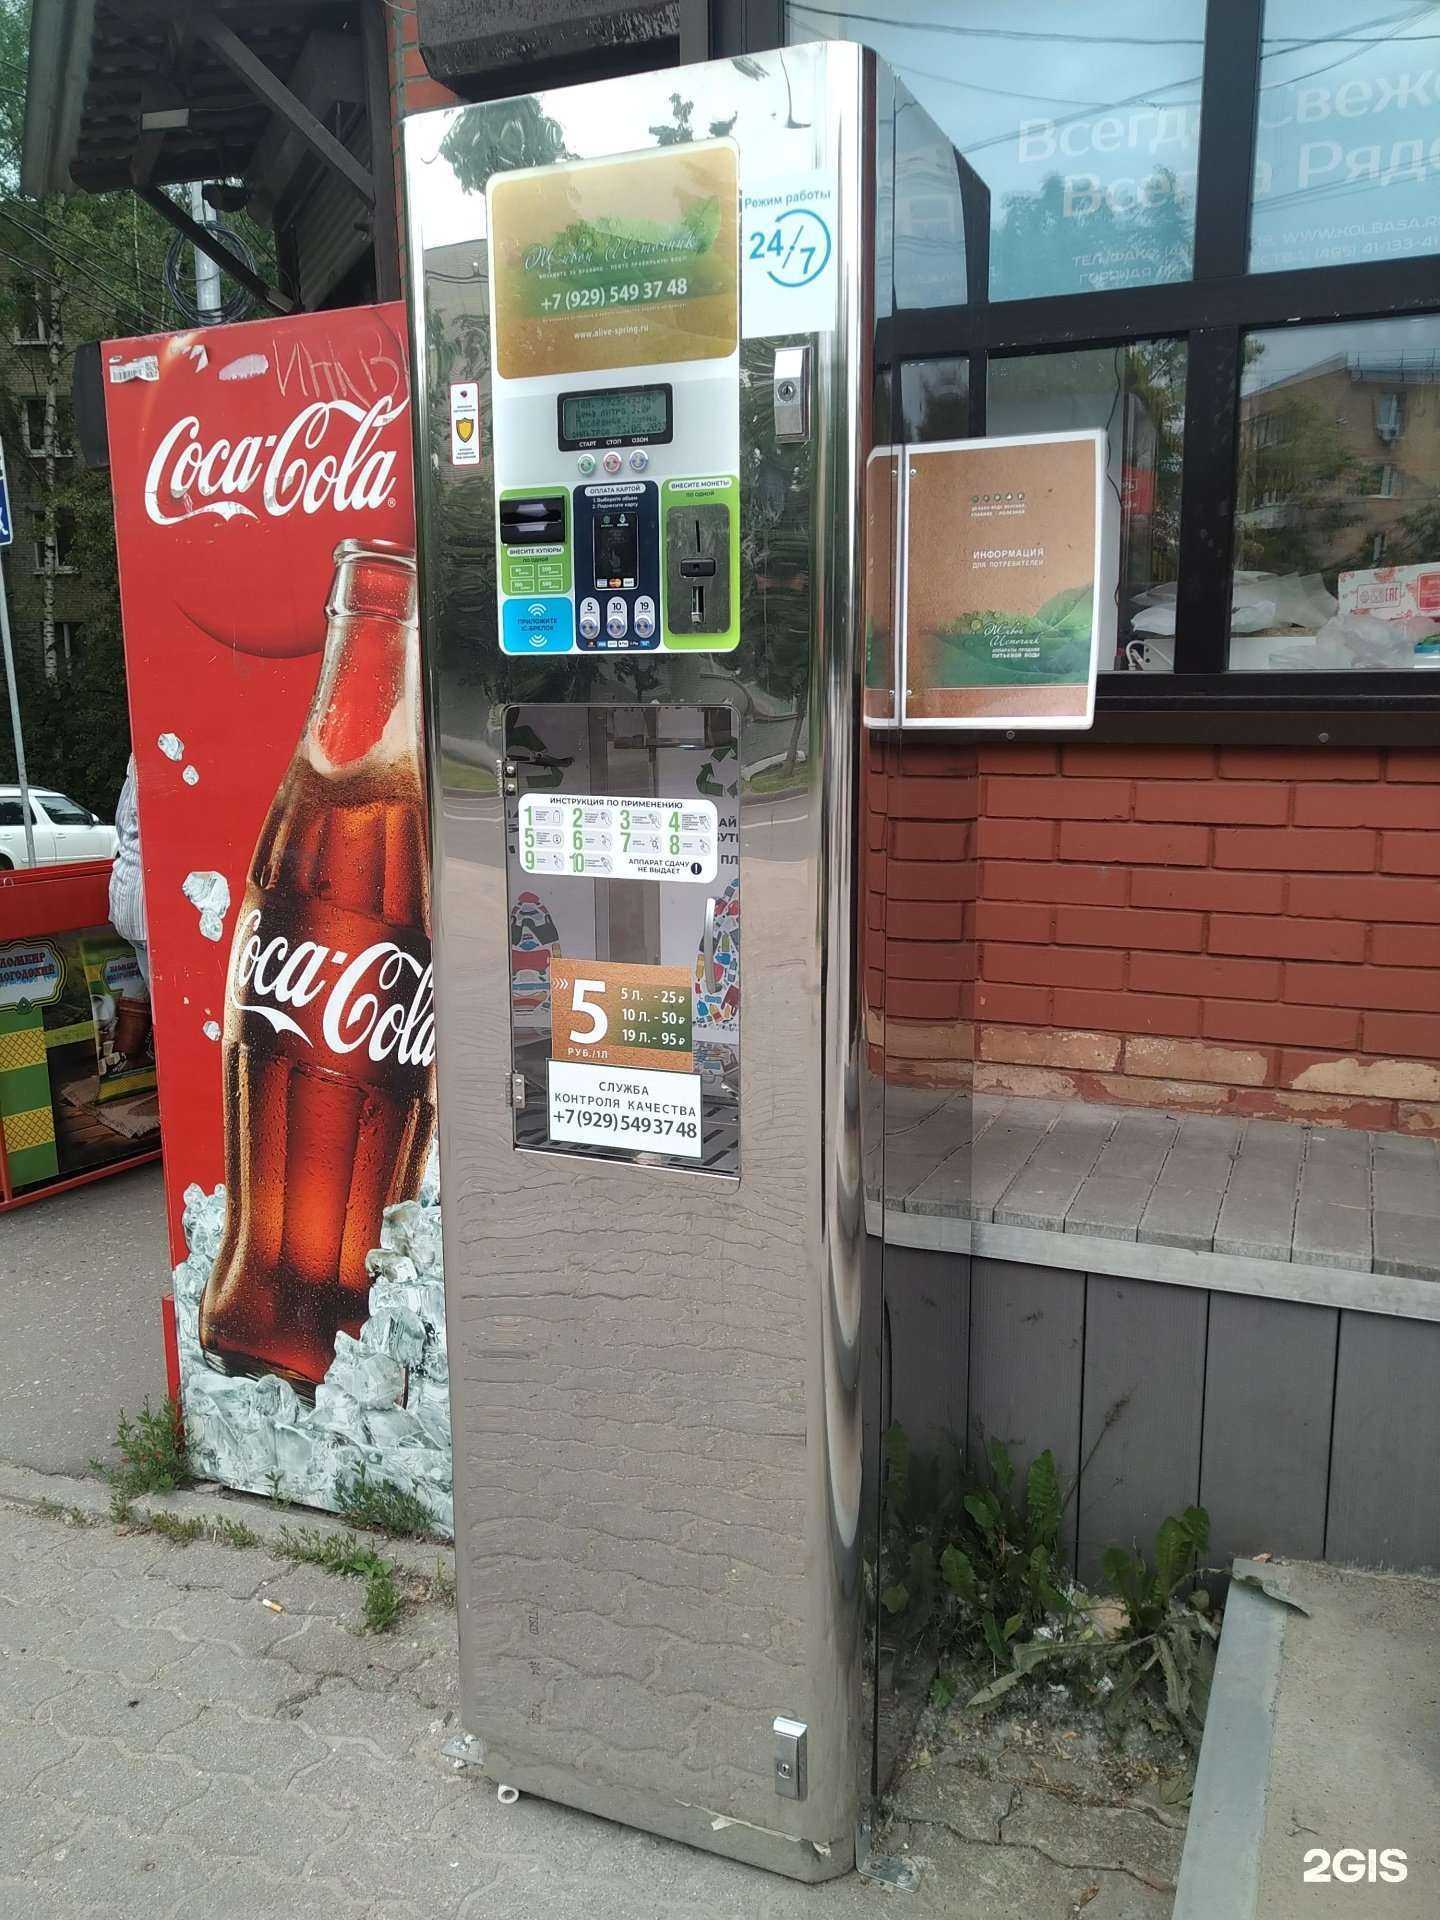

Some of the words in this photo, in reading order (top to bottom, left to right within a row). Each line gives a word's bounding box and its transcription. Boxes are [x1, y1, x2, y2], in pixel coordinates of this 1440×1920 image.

[744, 196, 782, 209] Режим
[786, 190, 831, 206] работы
[749, 225, 816, 274] 24/7
[541, 293, 562, 312] +7
[565, 286, 605, 311] (929)
[610, 284, 639, 304] 549
[643, 280, 663, 299] 37
[667, 278, 688, 296] 48
[574, 325, 649, 340] www.alive-spring.ru
[578, 440, 597, 448] СТАРТ
[145, 393, 410, 526] Coca-Cola
[589, 487, 615, 495] ОПЛАТА
[616, 485, 641, 493] КАРТОЙ
[701, 480, 730, 488] МОНЕТЫ
[509, 548, 535, 556] ВНЕСИТЕ
[536, 546, 562, 554] КУПЮРЫ
[973, 547, 1044, 560] ИНФОРМАЦИЯ
[587, 602, 593, 611] 5
[612, 602, 622, 611] 10
[640, 601, 649, 611] 19
[550, 797, 604, 807] ИНСТРУКЦИЯ
[606, 799, 619, 807] ПО
[621, 799, 683, 809] ПРИМЕНЕНИЮ
[524, 805, 532, 826] 1
[572, 807, 583, 828] 2
[619, 809, 630, 830] 3
[668, 811, 681, 833] 4
[524, 828, 535, 848] 5
[572, 830, 583, 851] 6
[620, 832, 631, 853] 7
[669, 834, 680, 855] 8
[525, 850, 535, 870] 9
[569, 853, 584, 873] 10
[629, 858, 663, 868] АППАРАТ
[665, 859, 690, 869] СДАЧУ
[649, 867, 681, 875] ВЫДАЕТ
[620, 987, 629, 1000] 5
[631, 990, 644, 1001] Л.
[569, 979, 609, 1045] 5
[622, 1008, 636, 1021] 10
[622, 1029, 636, 1042] 19
[598, 1081, 649, 1096] СЛУЖБА
[554, 1092, 620, 1109] КОНТРОЛЯ
[628, 1100, 696, 1117] КАЧЕСТВА
